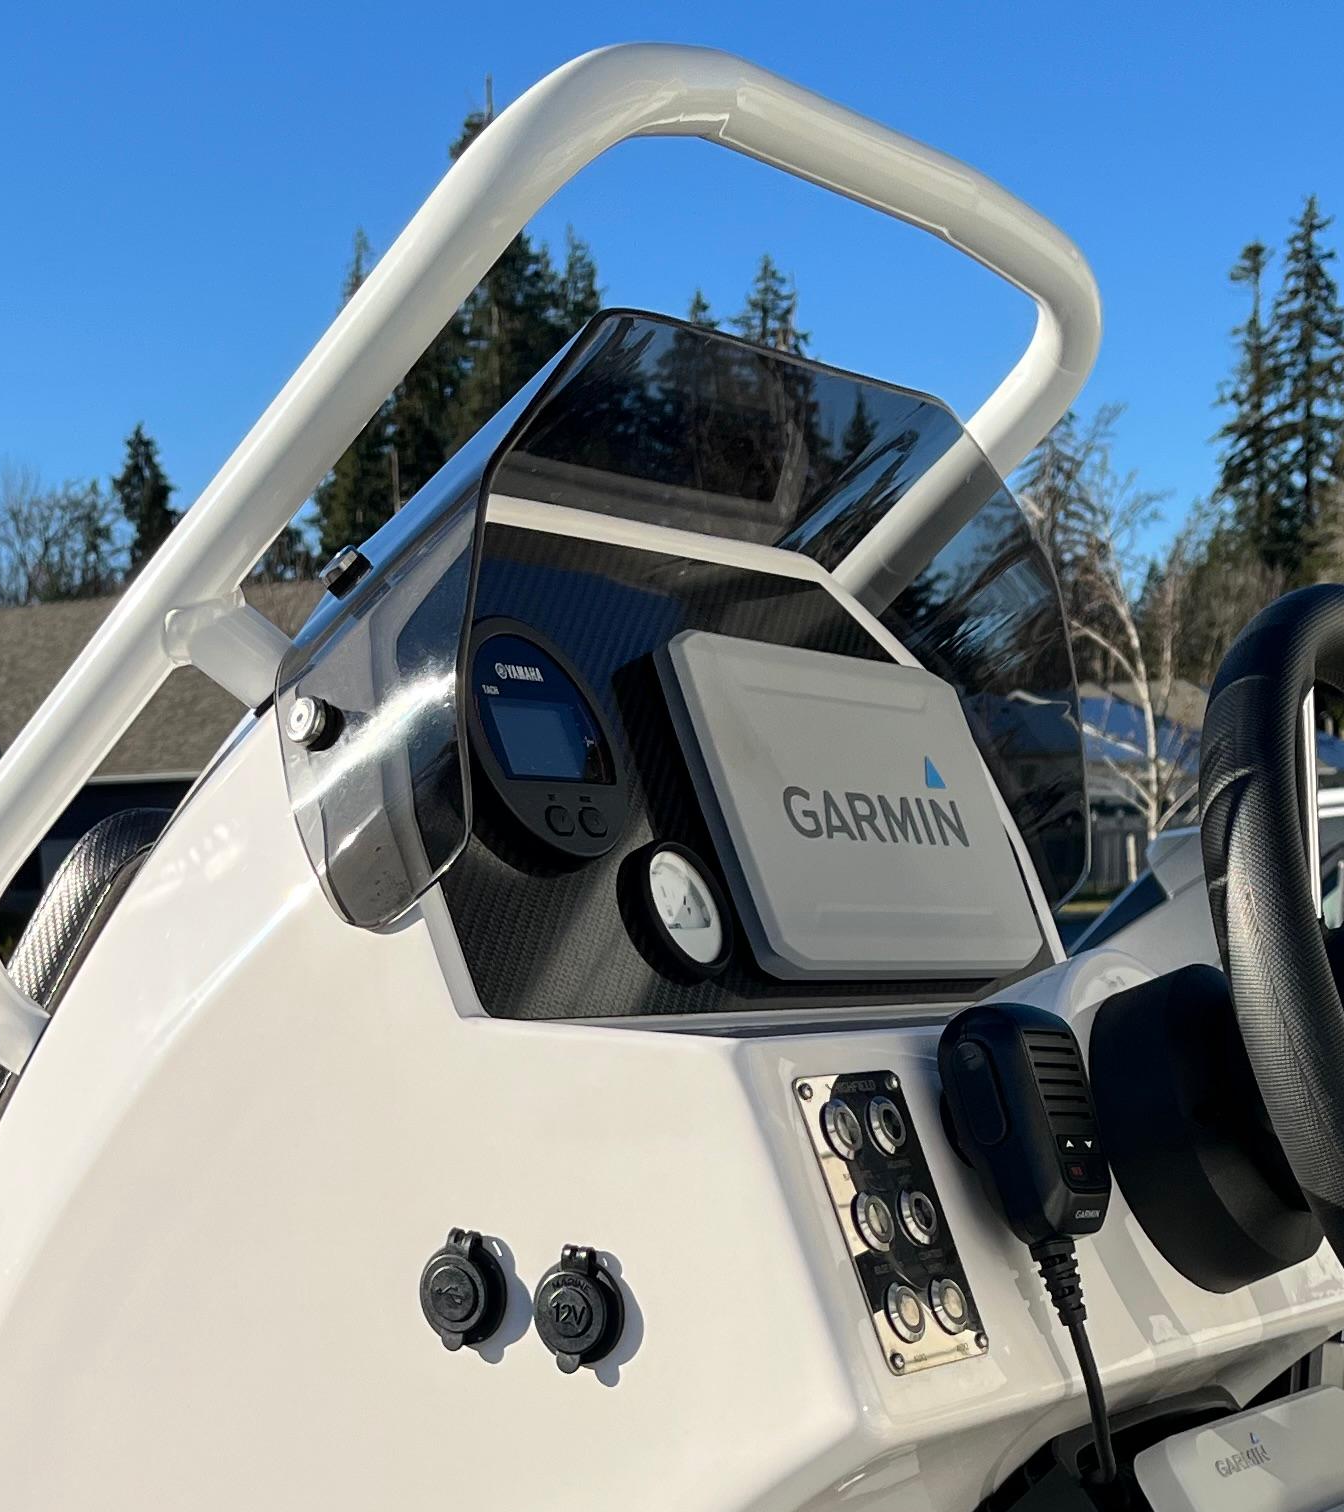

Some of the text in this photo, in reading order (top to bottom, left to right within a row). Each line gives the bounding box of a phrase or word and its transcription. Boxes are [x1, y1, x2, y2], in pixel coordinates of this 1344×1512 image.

[504, 664, 544, 682] YAMAHA
[783, 786, 969, 848] GARMIN
[1074, 1209, 1101, 1219] GARMIN
[552, 1302, 586, 1326] 12V
[1215, 1444, 1272, 1478] GARMIN
